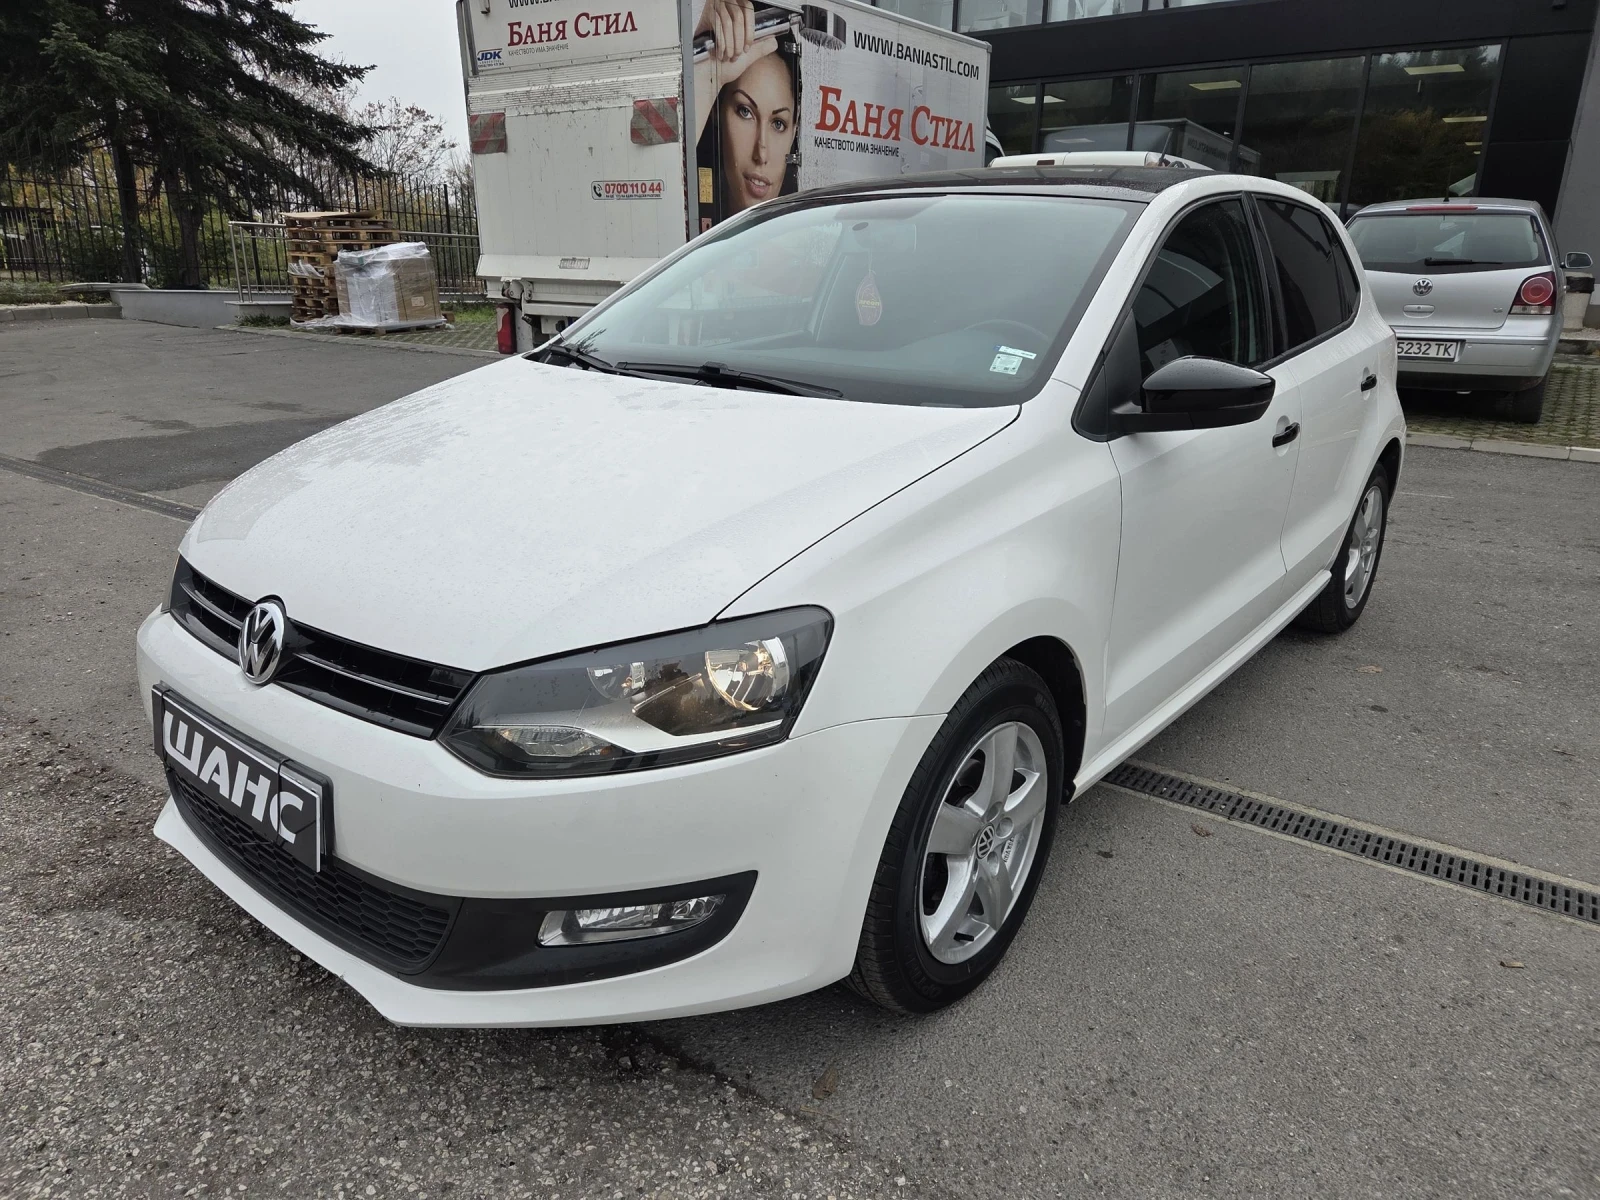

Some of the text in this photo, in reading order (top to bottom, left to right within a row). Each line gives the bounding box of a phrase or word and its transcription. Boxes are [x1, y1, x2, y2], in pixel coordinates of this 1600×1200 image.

[477, 50, 502, 61] JDK
[853, 30, 980, 80] WWW.BANIASTIL.COM
[814, 135, 899, 158] КАЧЕСТВОТО ИМА ЗНАЧЕНИЕ
[605, 183, 628, 194] 0700
[1397, 341, 1454, 357] 5232 TK
[163, 710, 304, 844] ШАНС
